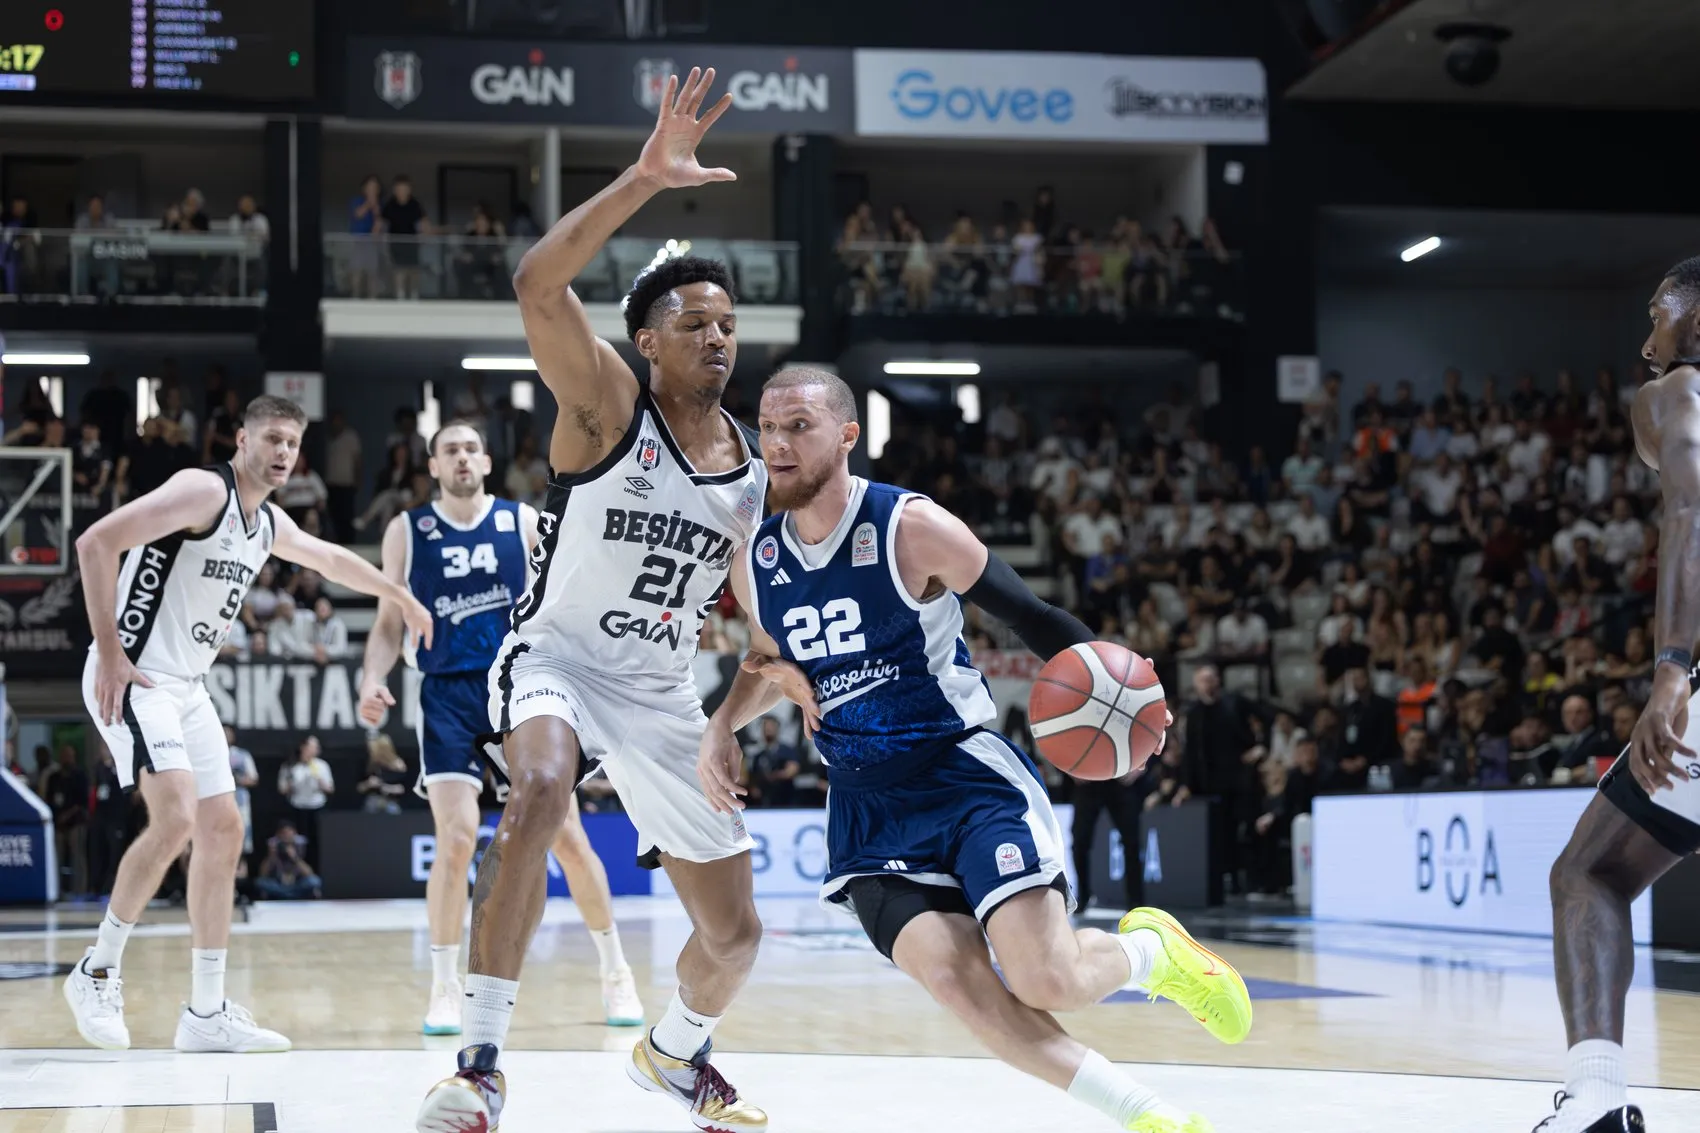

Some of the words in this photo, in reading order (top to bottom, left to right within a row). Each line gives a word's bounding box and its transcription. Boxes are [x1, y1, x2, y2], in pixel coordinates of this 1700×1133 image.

[0, 44, 45, 71] :17
[890, 69, 1074, 122] Govee
[623, 487, 649, 501] umbro
[441, 542, 499, 579] 34
[628, 554, 697, 608] 21
[219, 588, 241, 620] 9
[782, 597, 866, 661] 22
[1416, 814, 1503, 908] BOA
